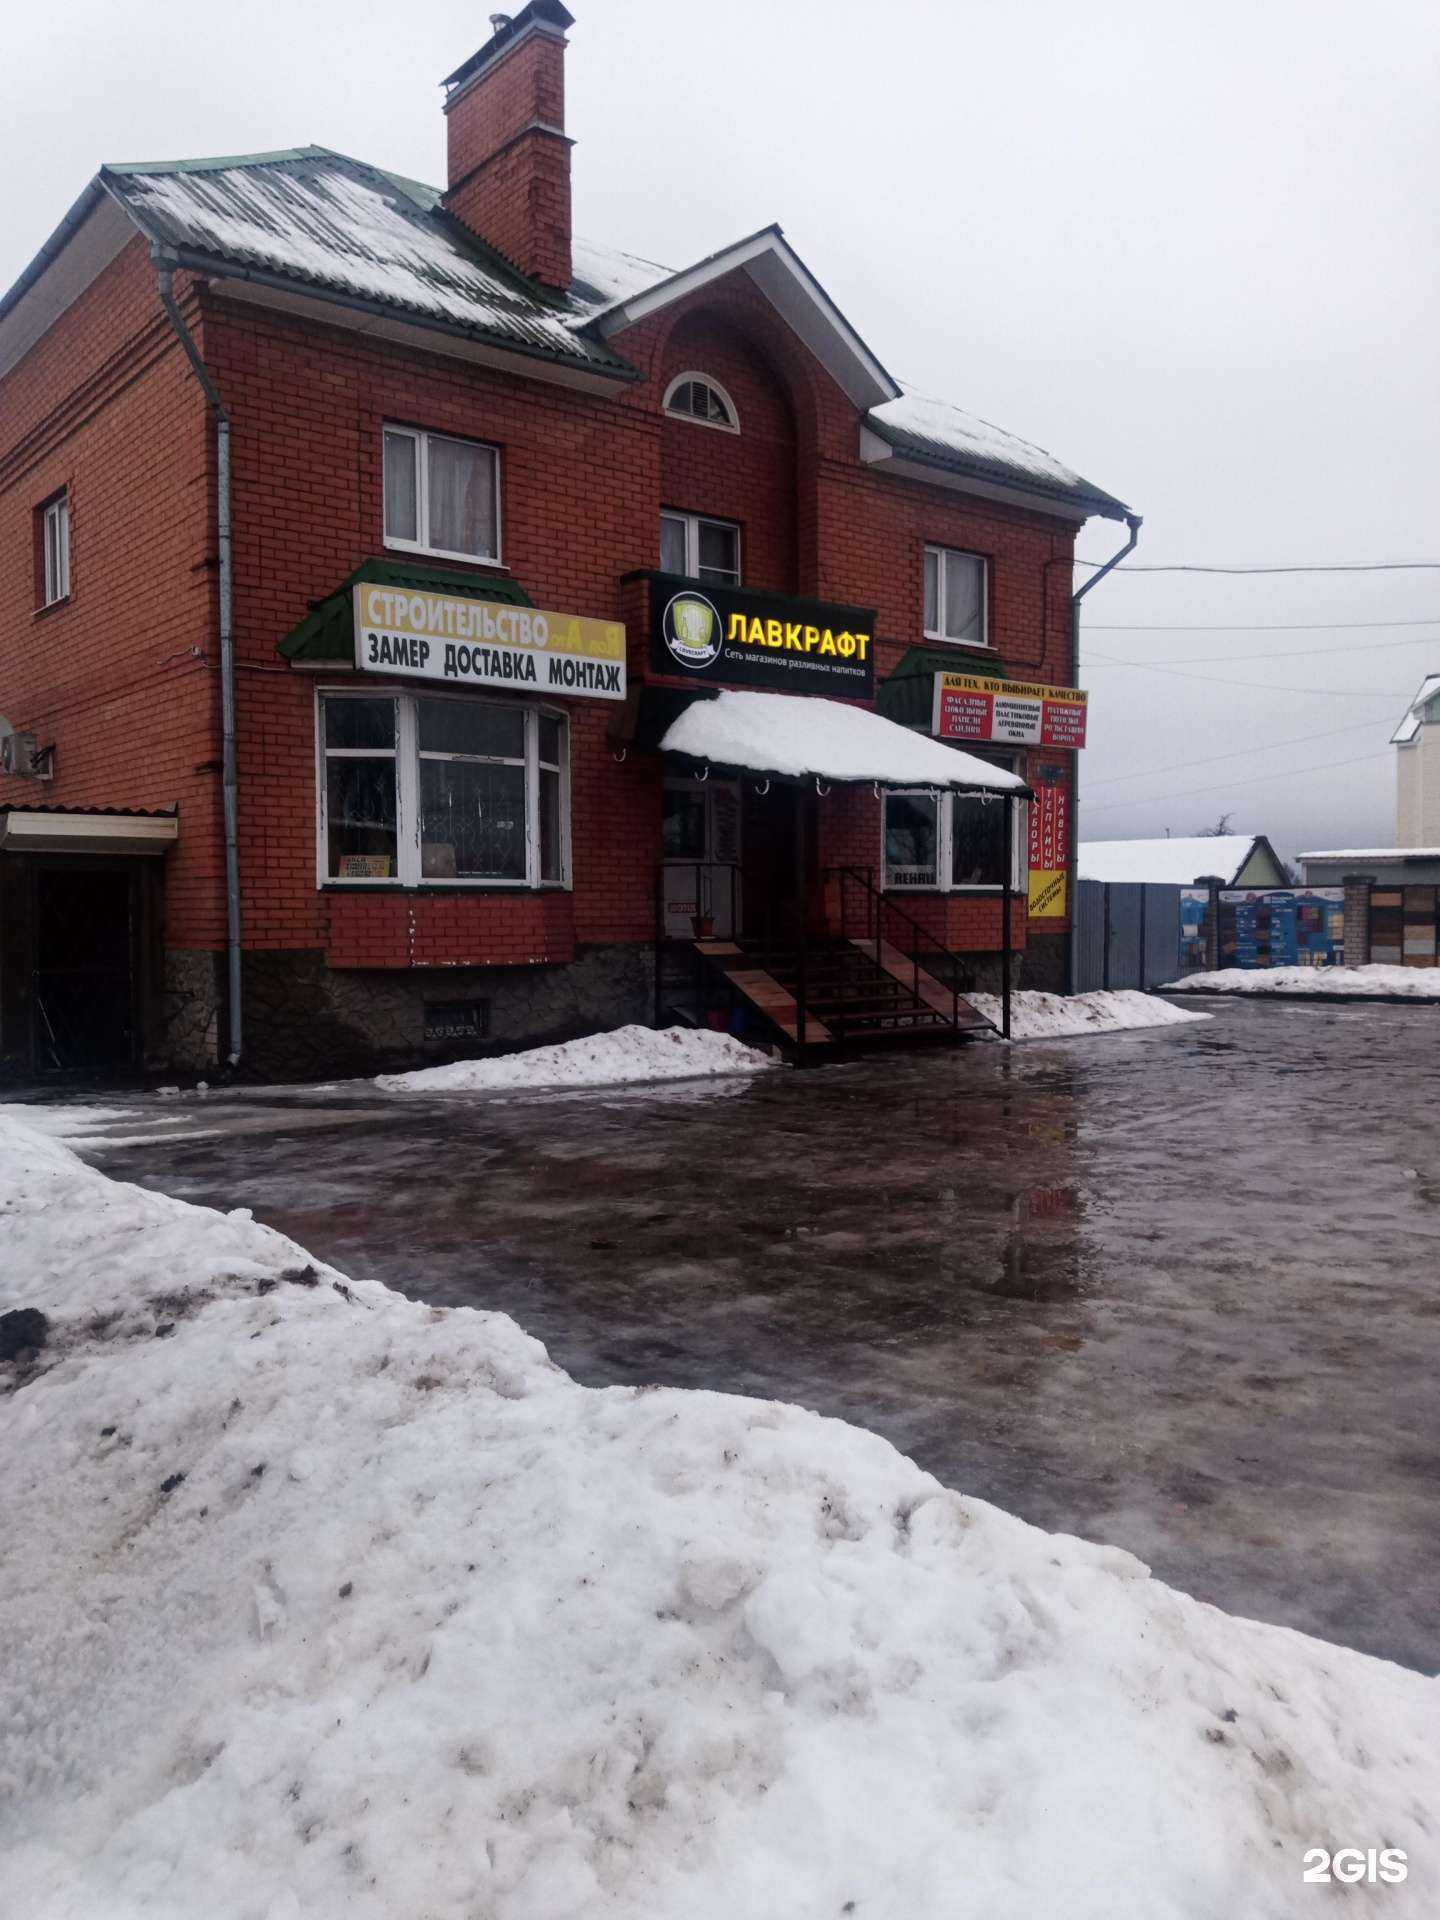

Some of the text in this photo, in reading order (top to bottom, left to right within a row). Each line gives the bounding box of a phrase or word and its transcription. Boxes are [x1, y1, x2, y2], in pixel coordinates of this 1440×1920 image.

[367, 591, 549, 648] СТРОИТЕЛЬСТВО
[727, 612, 870, 660] ЛАВКРАФТ
[367, 632, 621, 692] ЗАМЕР ДОСТАВКА МОНТАЖ
[724, 648, 867, 678] Сеть магазинов разливных напитков
[983, 682, 1000, 692] КТО
[1002, 683, 1045, 697] ВЫБИРАЕТ
[1048, 688, 1088, 702] КАЧЕСТВО
[1008, 729, 1025, 739] ОКНА
[1043, 789, 1053, 869] ТЕПЛИЦЫ
[1056, 795, 1065, 863] НАВЕСЫ
[1029, 872, 1065, 912] ВОДОСТОЧНЫЕ
